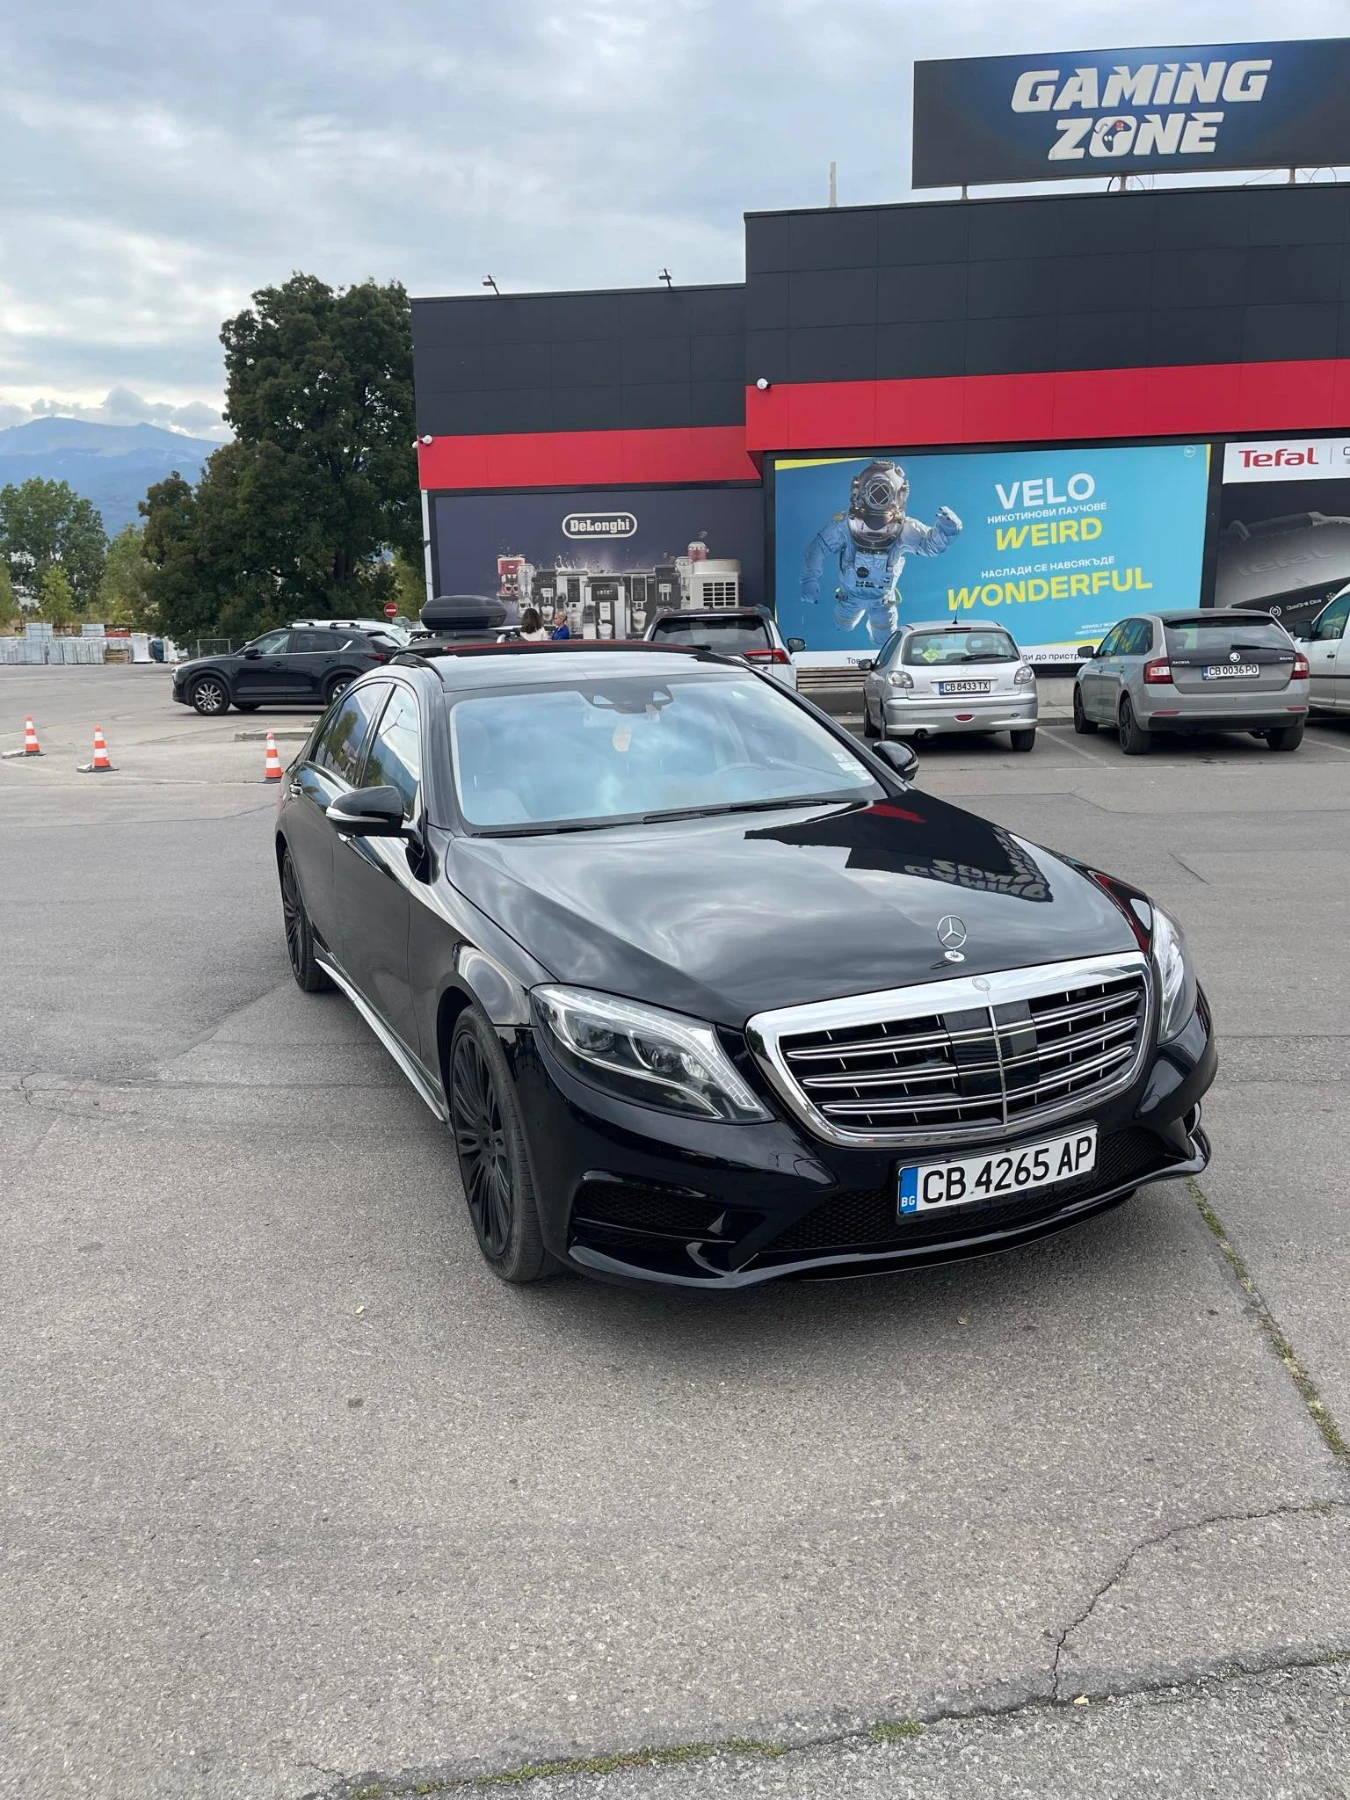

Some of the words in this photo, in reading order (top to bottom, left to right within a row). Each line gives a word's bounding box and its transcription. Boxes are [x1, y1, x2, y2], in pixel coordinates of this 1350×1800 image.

[1011, 59, 1272, 113] GAMING
[1048, 112, 1224, 161] ZONE
[1238, 447, 1319, 468] Tefal
[995, 473, 1095, 510] VELO
[987, 507, 1056, 524] НИКОТИНОВИ
[1058, 502, 1107, 516] ПАУЧОВЕ
[996, 517, 1103, 551] WEIRD
[981, 566, 1032, 579] НАСЛАДИ
[1034, 563, 1048, 572] СЕ
[1050, 556, 1115, 571] НАВСЯКЪДЕ
[947, 567, 1153, 611] WONDERFUL
[1209, 666, 1221, 676] CB
[1223, 665, 1245, 675] 0036
[1245, 665, 1258, 674] PO
[944, 683, 956, 692] CB
[956, 682, 977, 691] 8433
[978, 681, 989, 690] TX
[923, 1166, 966, 1204] CB
[975, 1148, 1050, 1194] 4265
[1056, 1136, 1092, 1176] AP
[901, 1196, 915, 1208] BG
